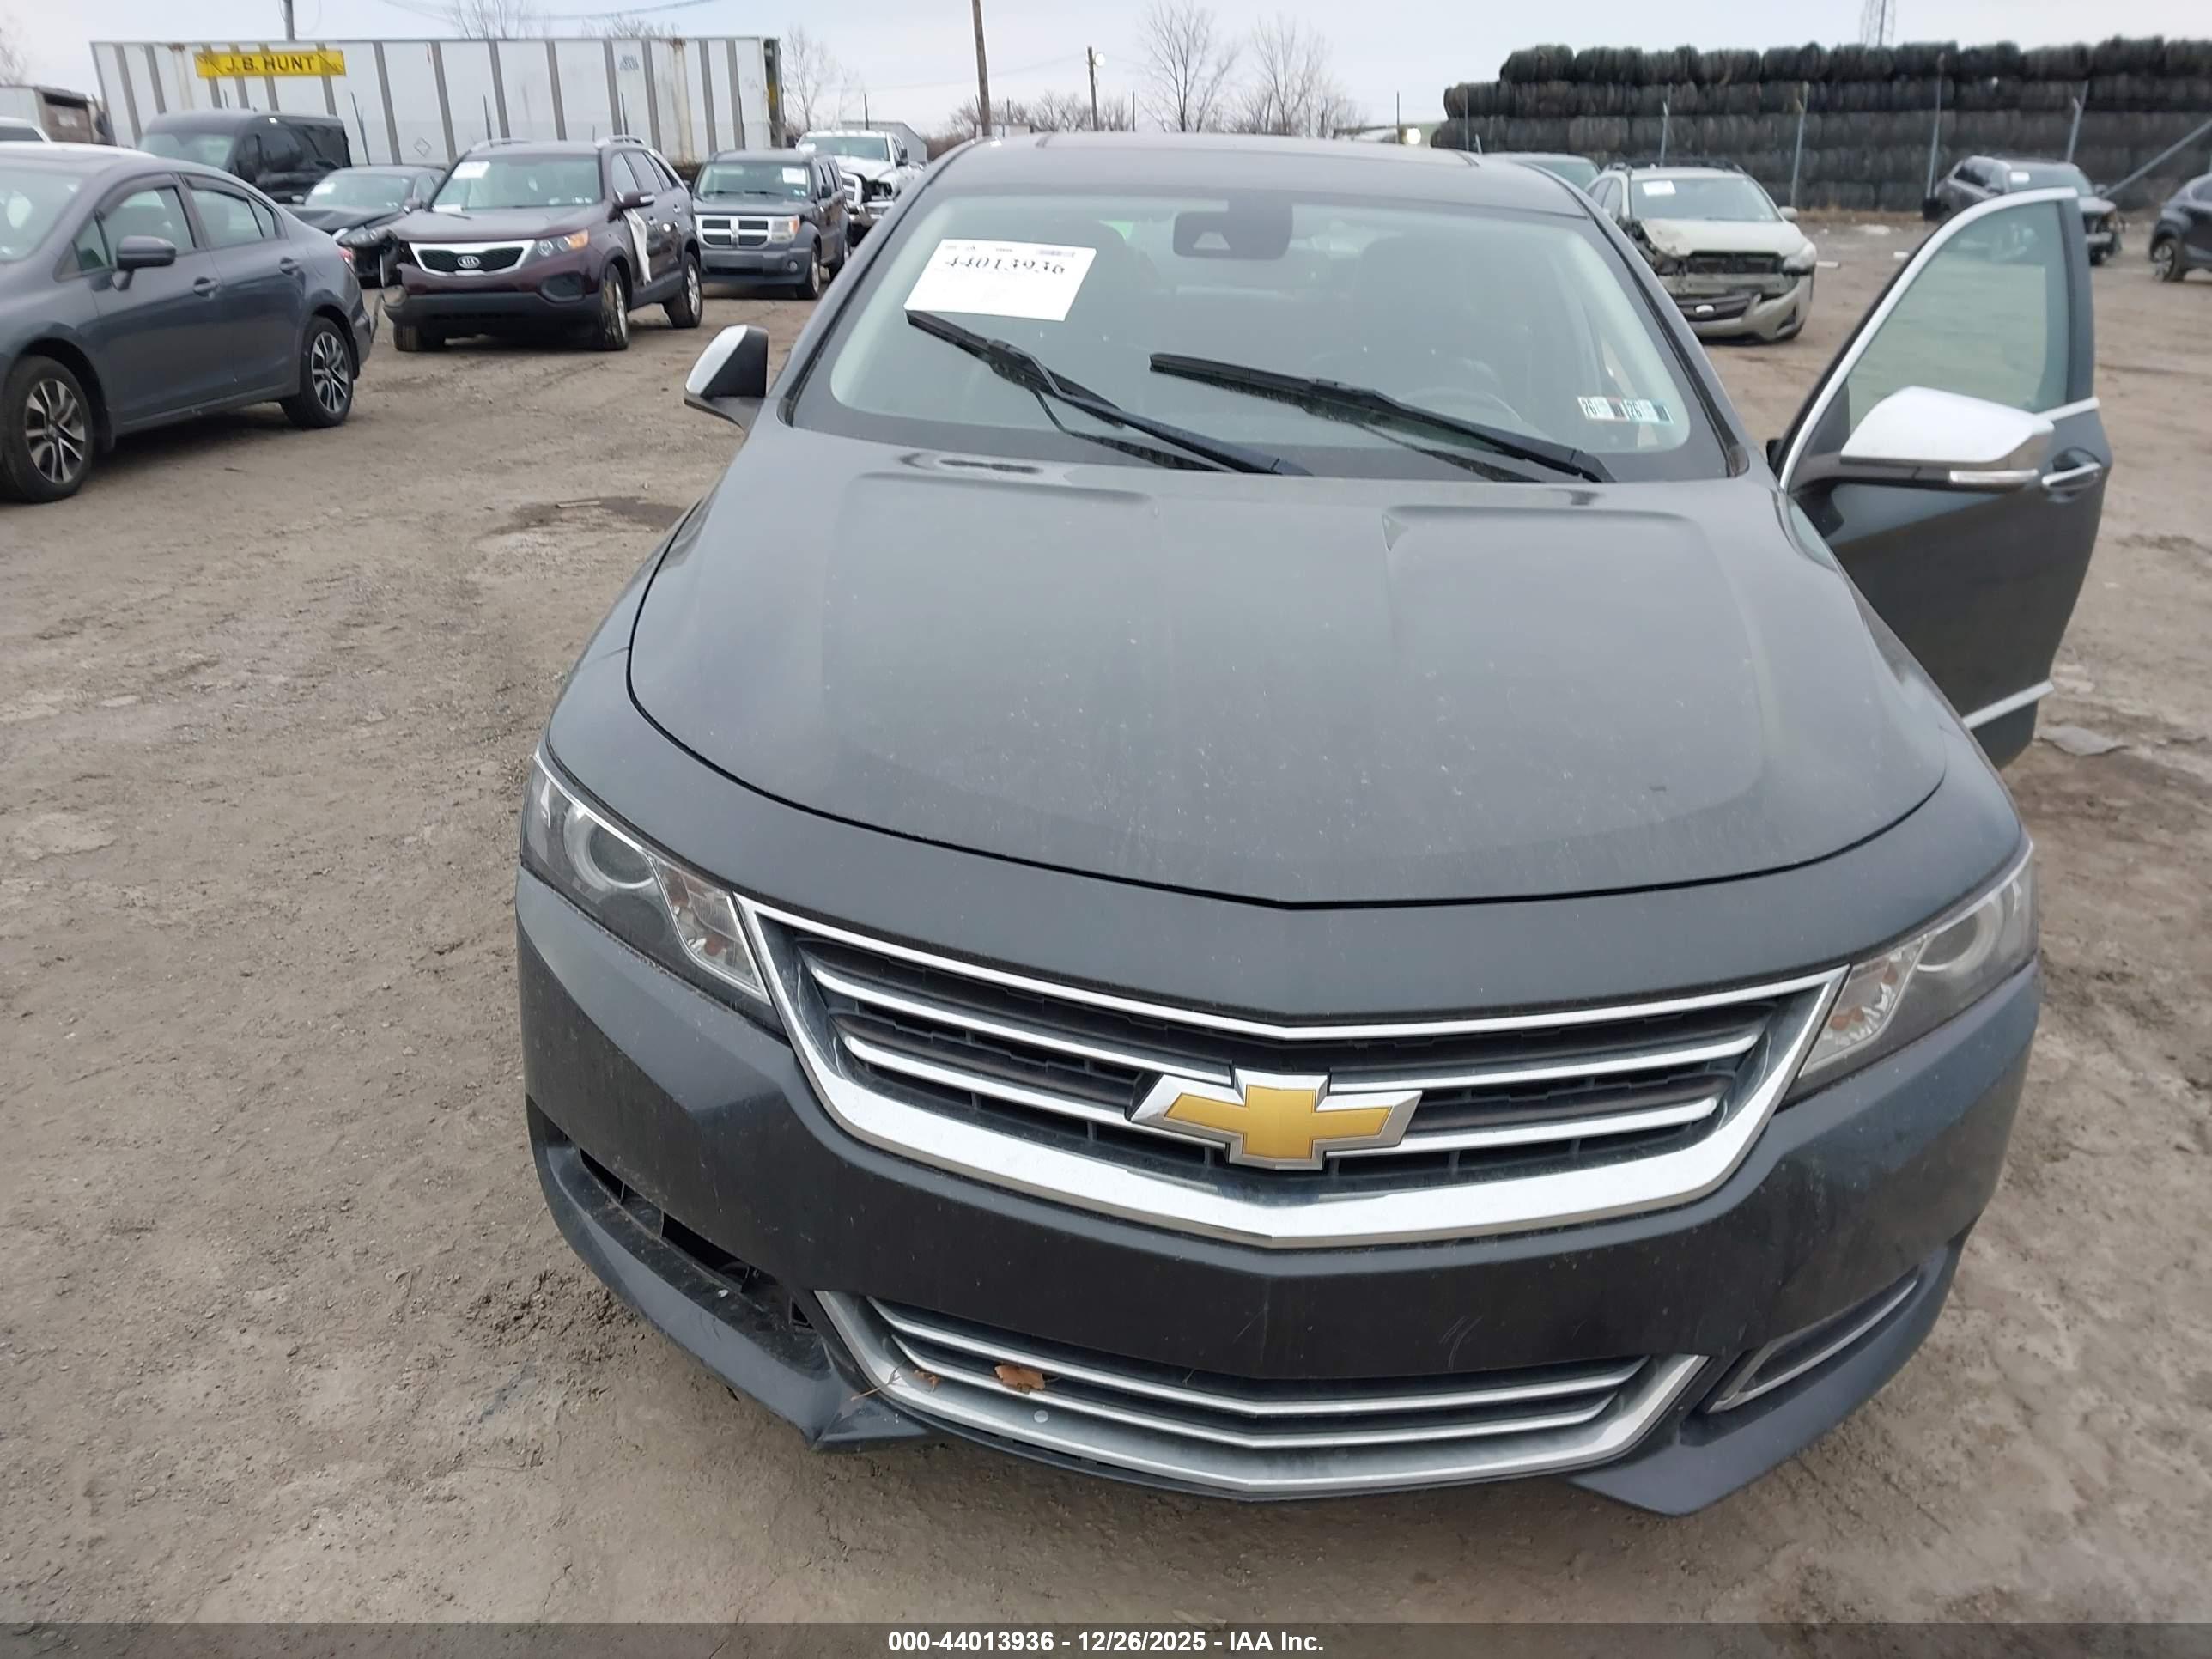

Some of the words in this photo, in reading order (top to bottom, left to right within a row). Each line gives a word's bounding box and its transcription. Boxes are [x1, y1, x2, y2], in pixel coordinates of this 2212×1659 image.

[263, 56, 315, 71] HUNT
[459, 257, 479, 267] KIA
[945, 256, 1066, 276] 44013936
